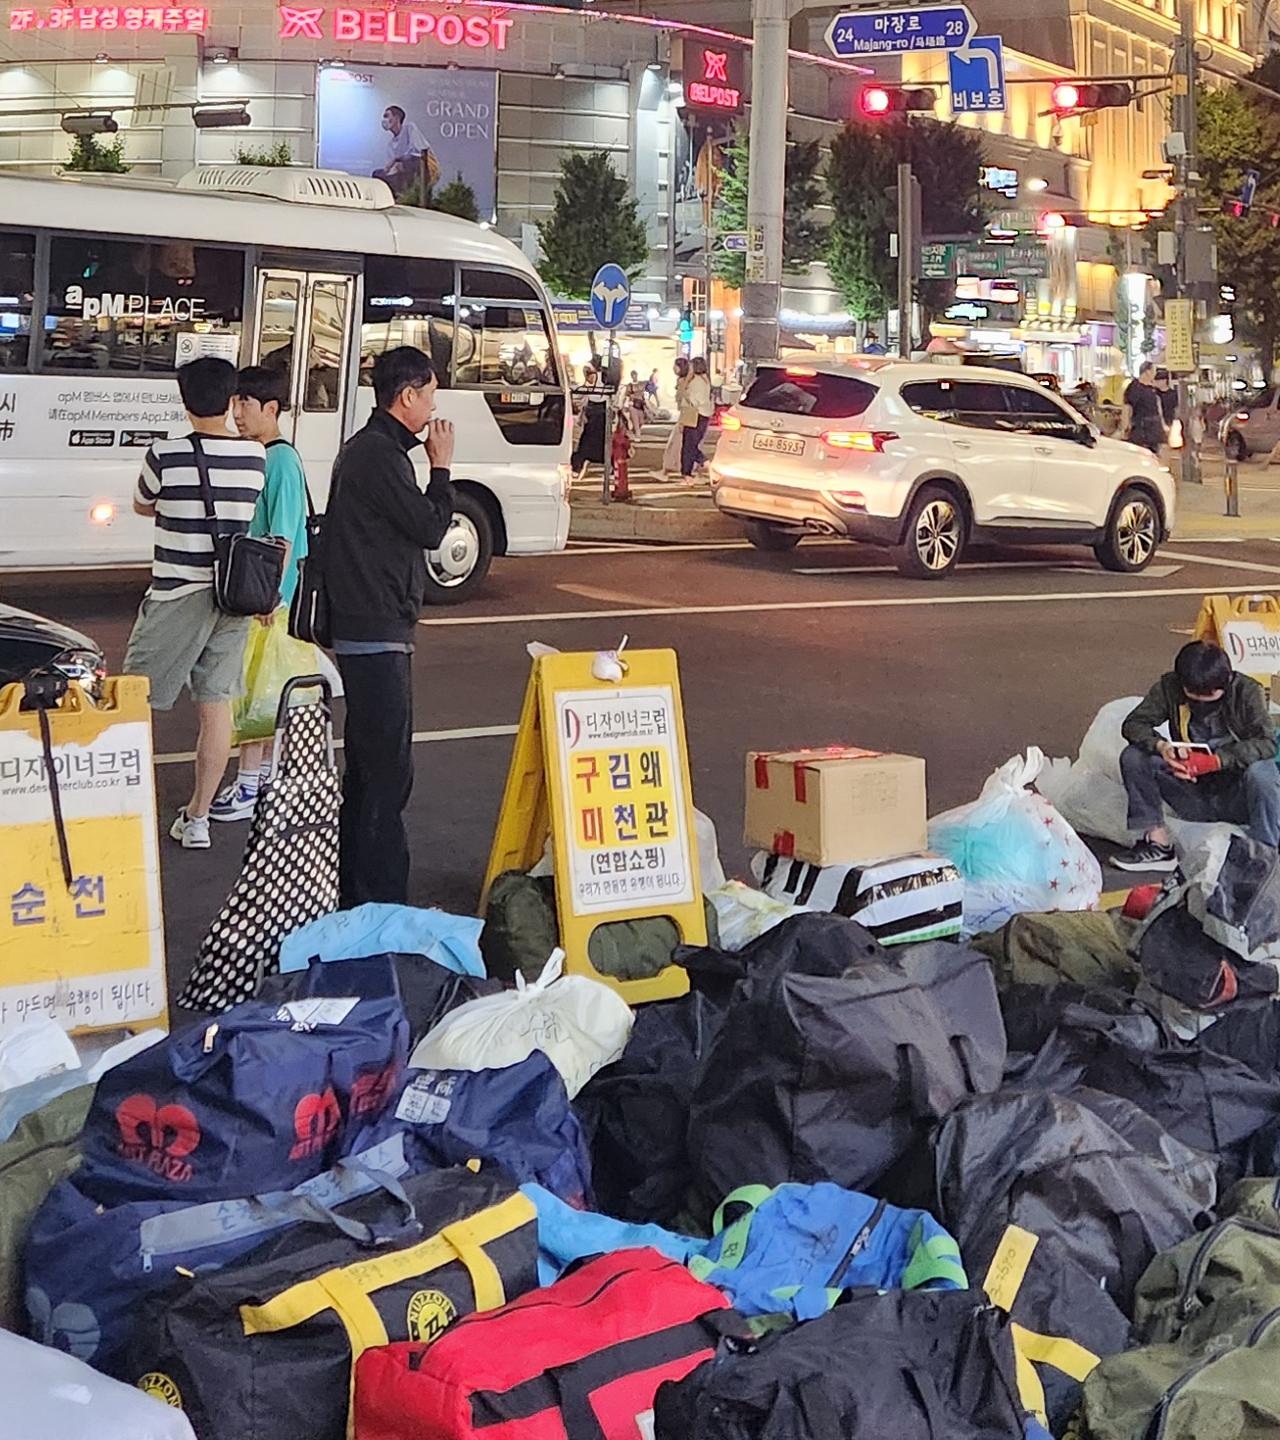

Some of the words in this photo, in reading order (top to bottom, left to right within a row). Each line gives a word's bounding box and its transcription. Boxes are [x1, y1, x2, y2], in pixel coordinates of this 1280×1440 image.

[50, 8, 75, 30] 3F
[79, 7, 119, 31] 남성
[334, 7, 514, 50] BELPOST
[837, 28, 854, 43] 24
[874, 15, 922, 34] 마장로
[946, 21, 963, 36] 28
[854, 38, 908, 52] Majang-ro
[689, 82, 740, 107] BELPOST
[953, 90, 1004, 110] 비보호
[426, 100, 489, 120] GRAND
[440, 122, 489, 139] OPEN
[65, 285, 125, 321] apM
[128, 295, 205, 322] PLACE
[586, 708, 667, 735] 디자이너크럽
[0, 748, 141, 786] 디자이너크럽
[590, 847, 665, 875] (연합쇼핑)
[66, 988, 104, 1017] 유행이
[409, 1293, 453, 1321] NUZZON
[144, 1376, 179, 1406] ZZON
